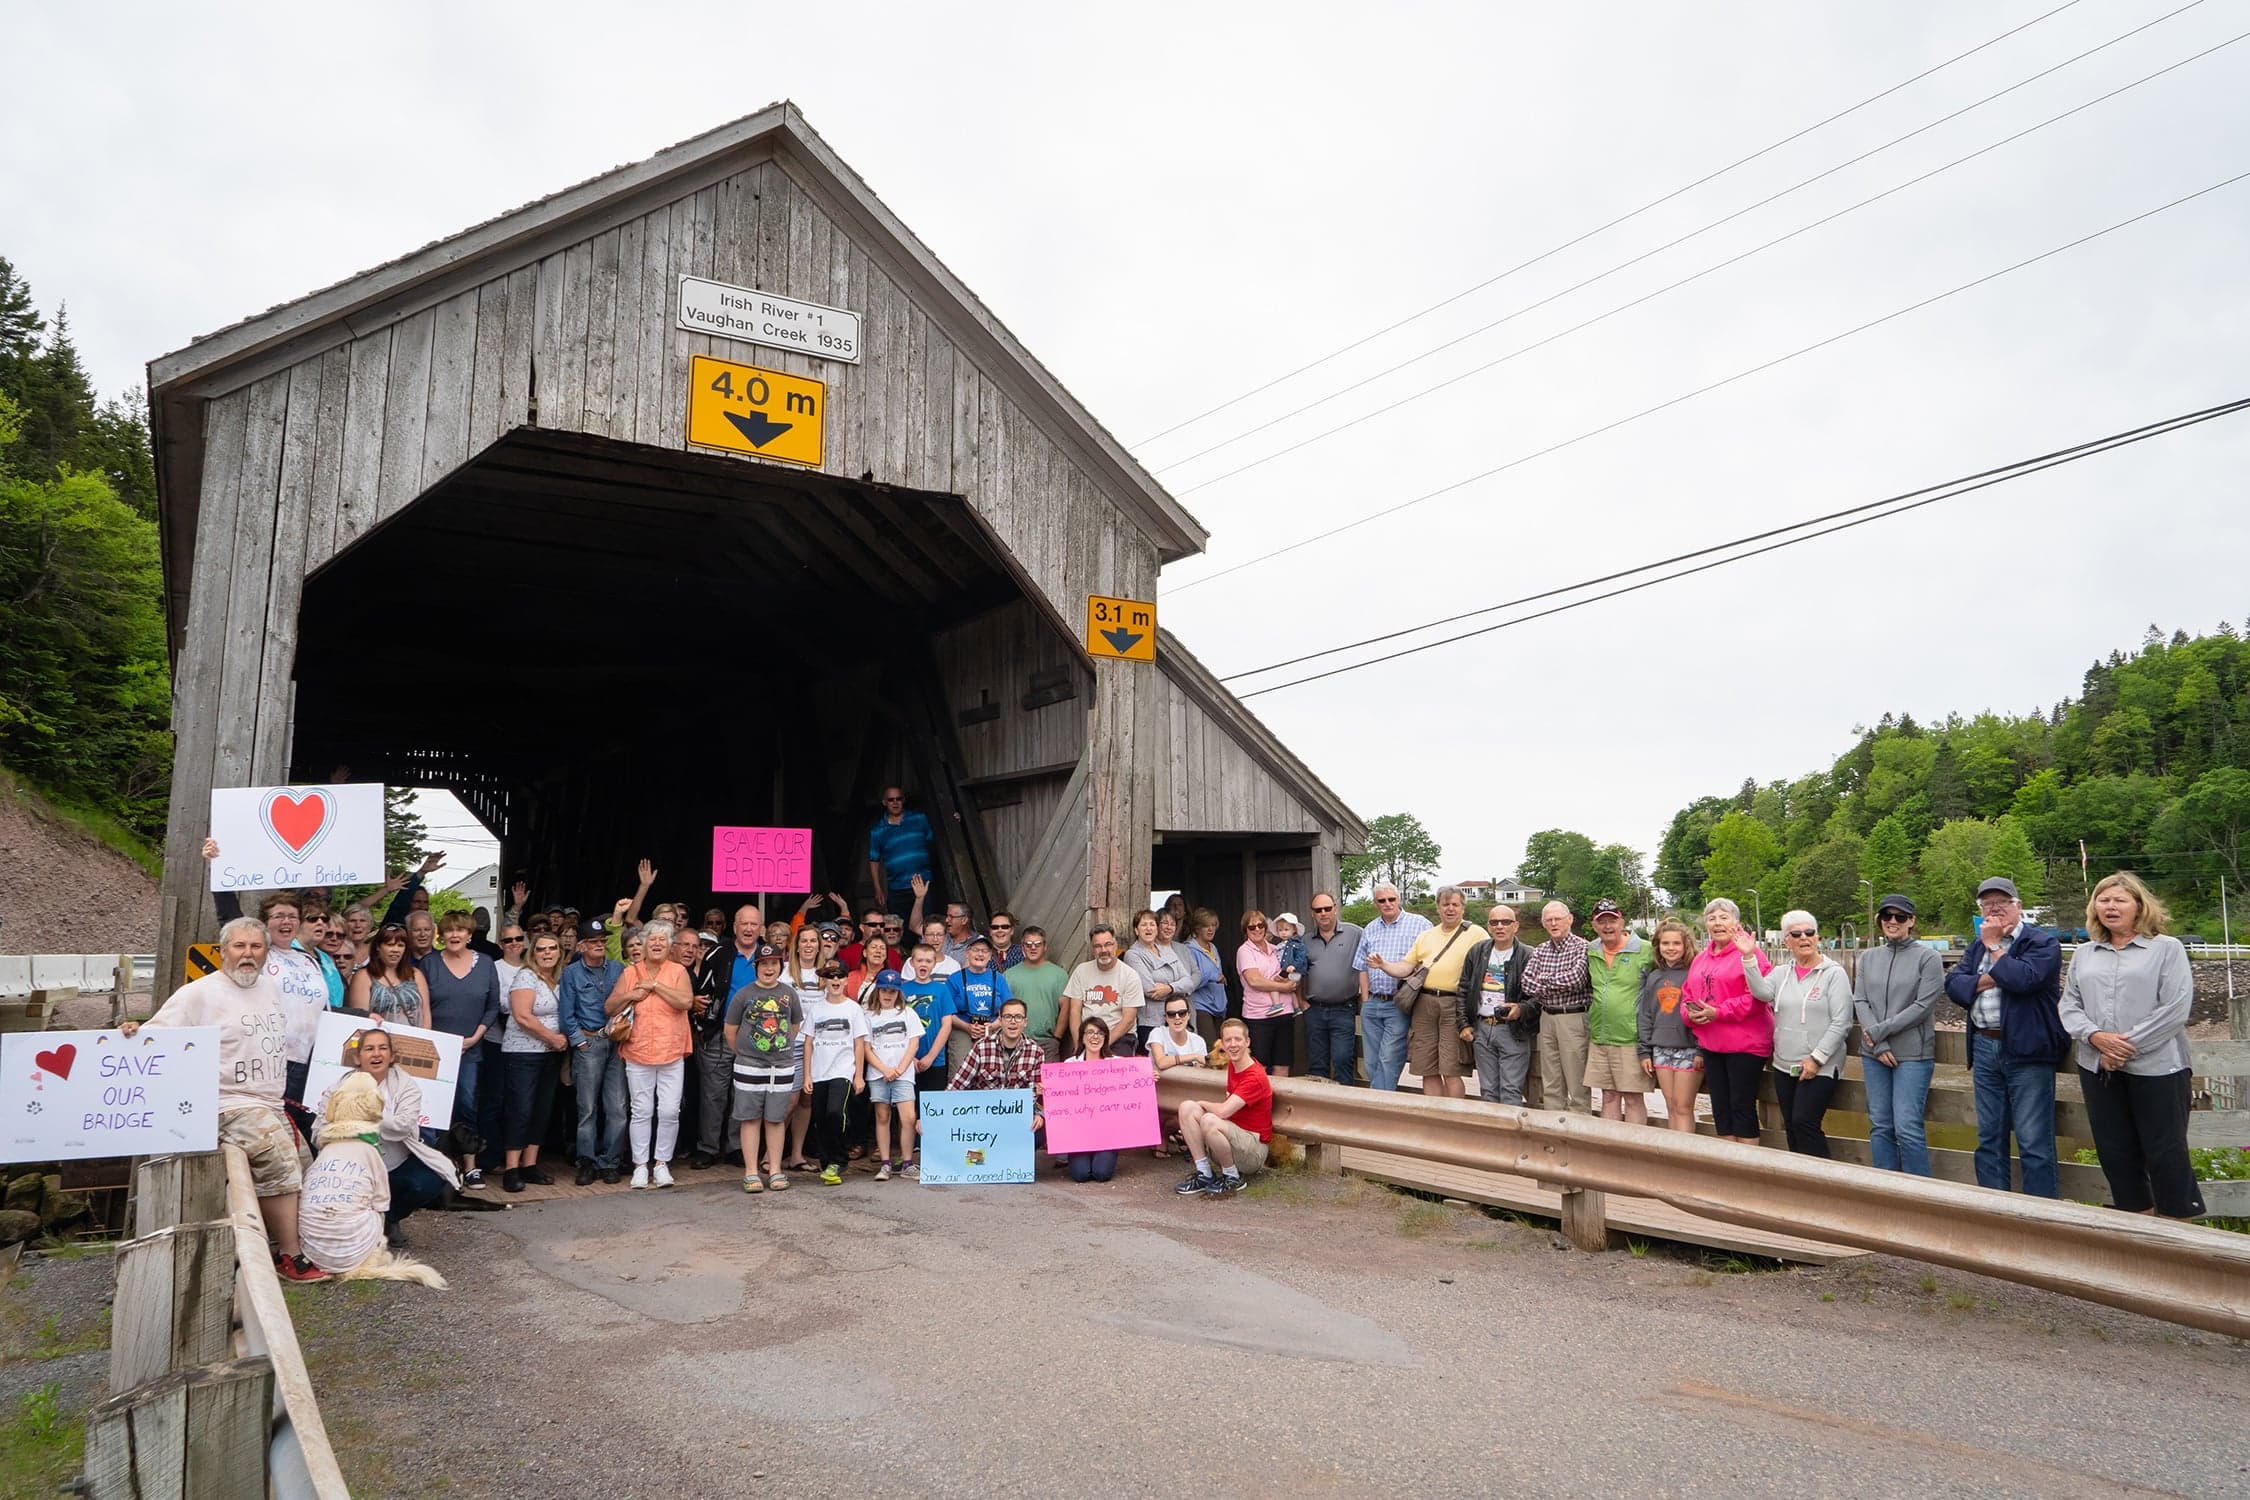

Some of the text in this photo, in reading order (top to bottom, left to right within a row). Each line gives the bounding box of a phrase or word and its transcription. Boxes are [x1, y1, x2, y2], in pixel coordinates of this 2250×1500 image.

[720, 293, 753, 311] Irish
[761, 302, 800, 321] River
[686, 306, 853, 352] Vaughan Creek 1935
[711, 371, 816, 416] 4.0 m
[1095, 602, 1149, 627] 3.1 m
[722, 831, 806, 855] SAVE OUR
[220, 864, 359, 888] Save Our Bridge
[724, 857, 804, 889] BRIDGE
[241, 1013, 278, 1037] SAVE
[100, 1055, 166, 1078] SAVE
[1059, 1068, 1089, 1080] Europe
[1110, 1064, 1127, 1077] keep
[103, 1086, 146, 1106] OUR
[1043, 1085, 1079, 1097] Covered
[1084, 1083, 1117, 1096] Bridges
[1132, 1077, 1154, 1090] 800
[922, 1102, 944, 1117] You
[986, 1099, 1024, 1116] rebuild
[1074, 1103, 1095, 1119] why
[83, 1111, 155, 1130] BRIDGE
[950, 1127, 998, 1148] History
[342, 1160, 366, 1177] MY
[920, 1167, 942, 1183] Save
[944, 1174, 961, 1183] our
[966, 1168, 1004, 1183] covered
[308, 1176, 362, 1191] BRIDGE
[310, 1193, 353, 1204] PLEASE
